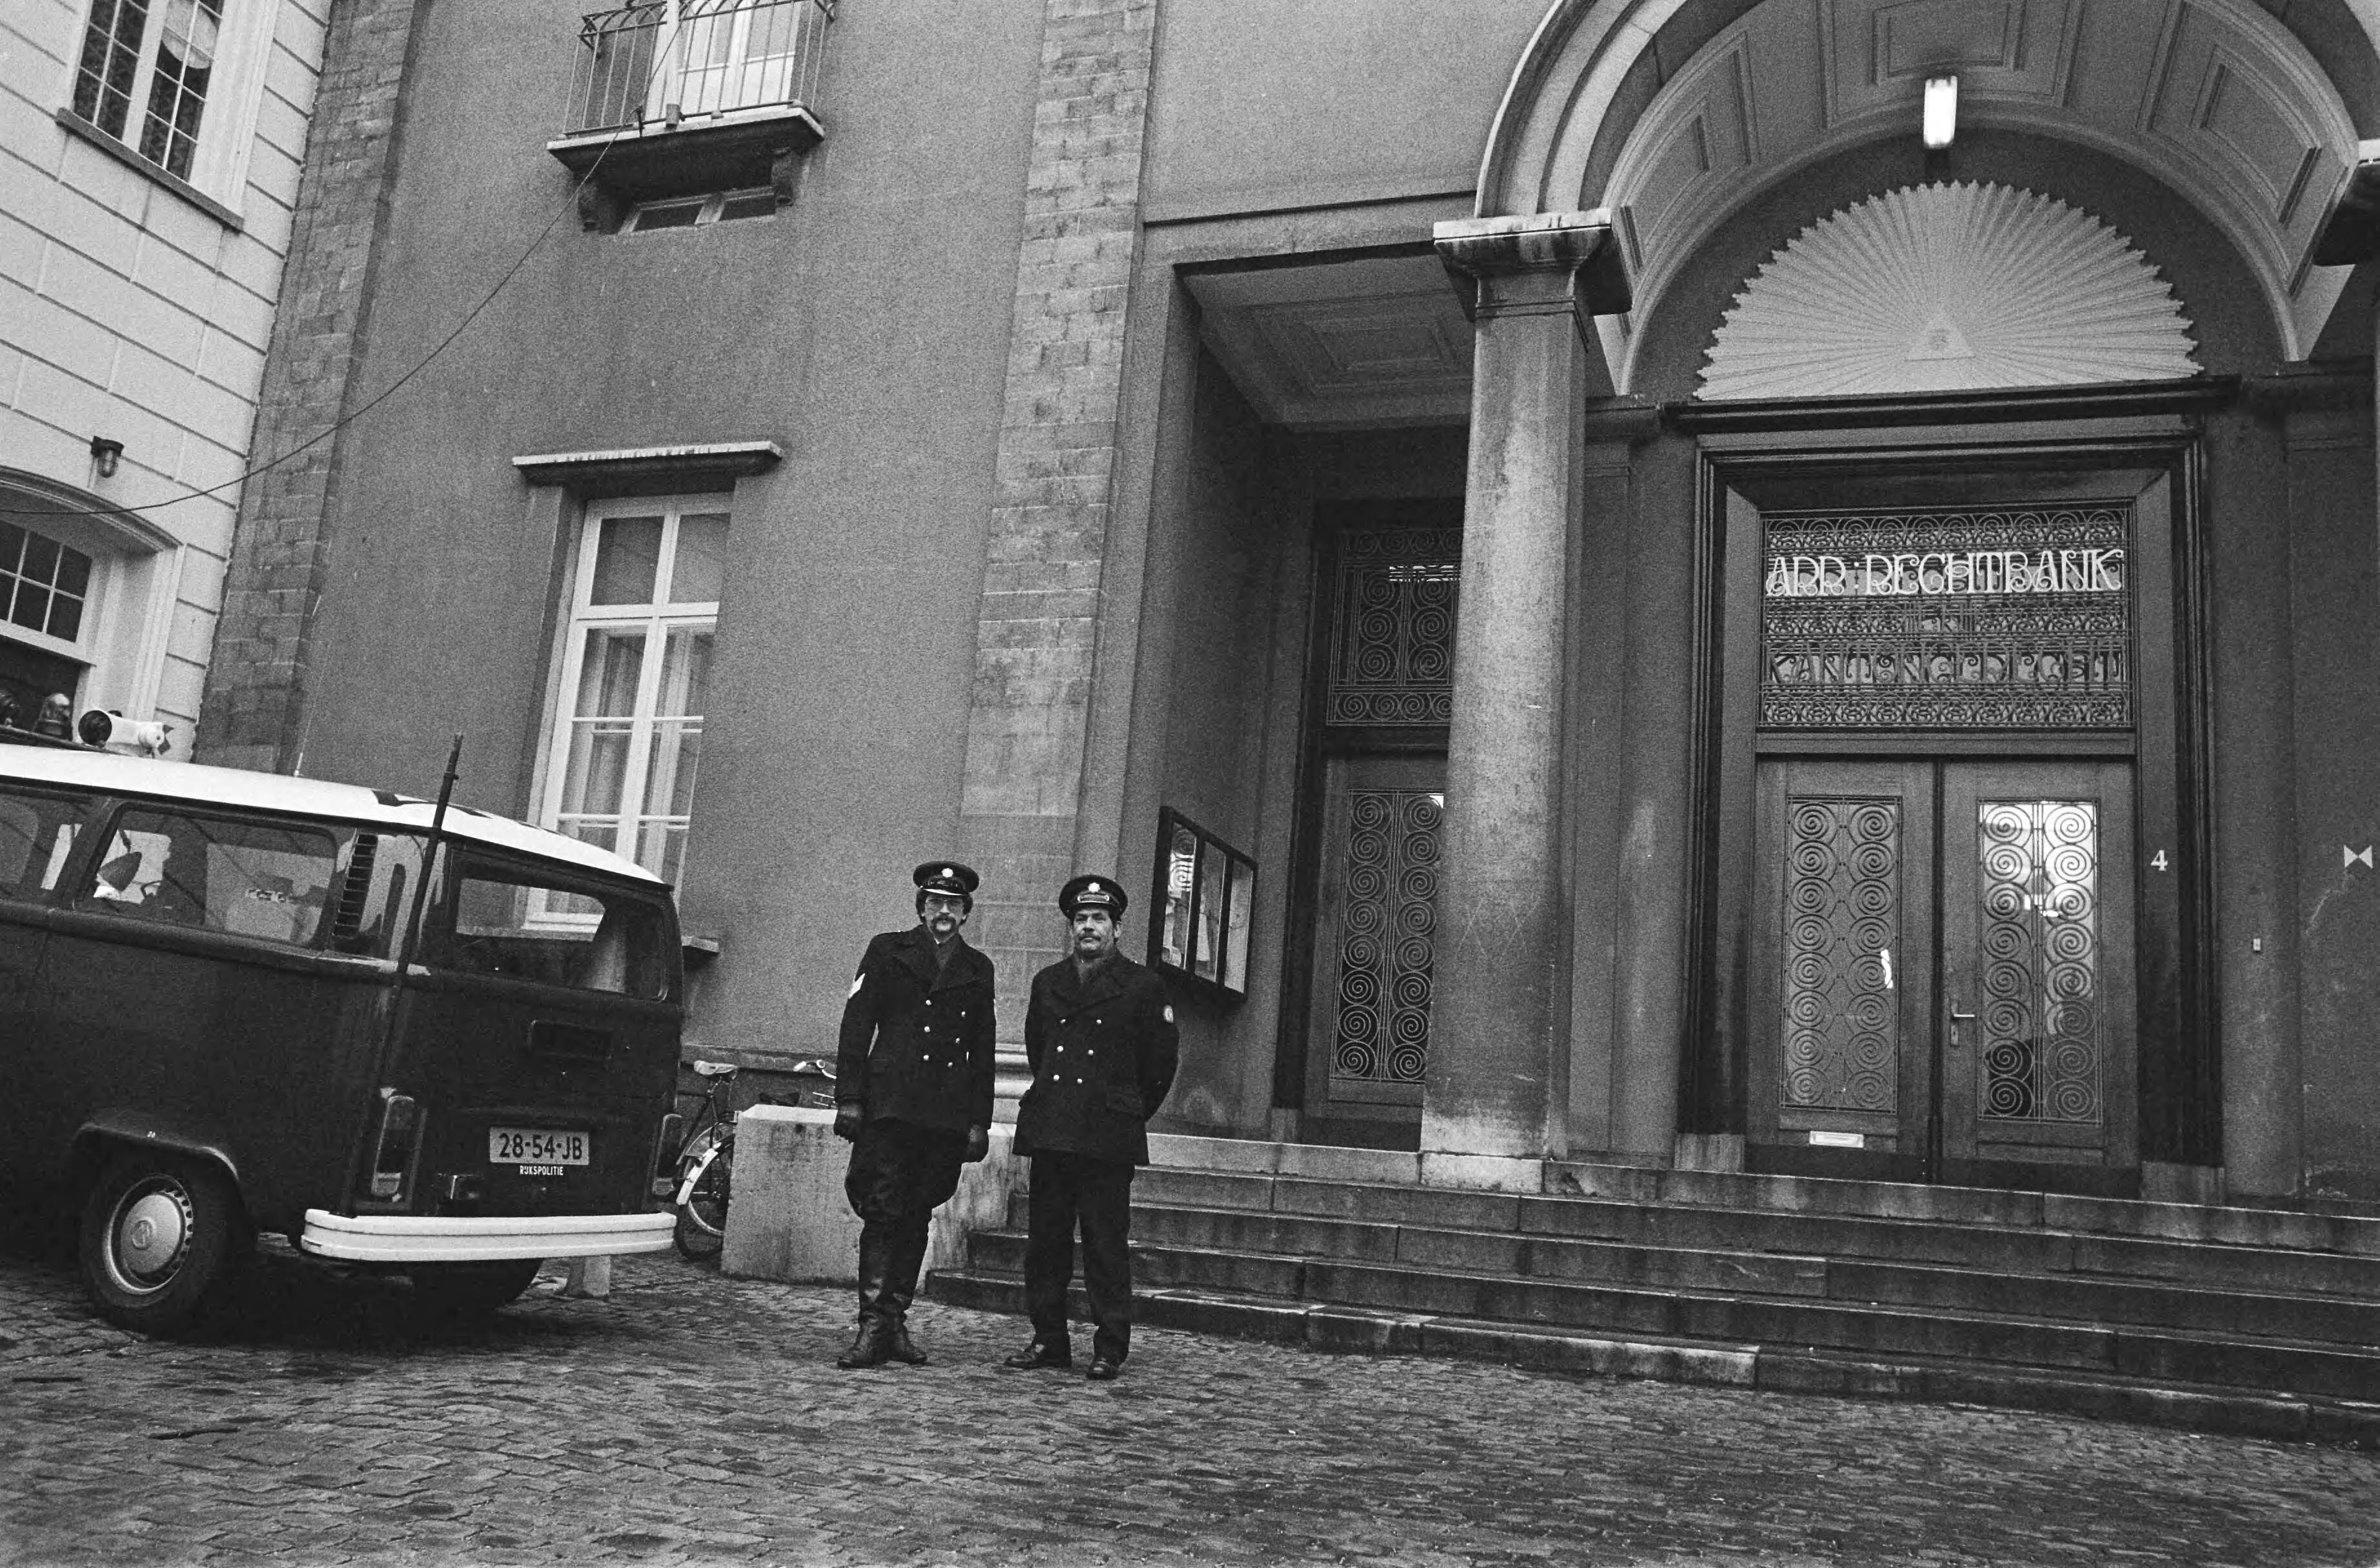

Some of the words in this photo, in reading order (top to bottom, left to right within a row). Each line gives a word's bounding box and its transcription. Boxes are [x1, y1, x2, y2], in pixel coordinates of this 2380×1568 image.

[1865, 548, 2124, 596] RECHTBANK
[1766, 639, 2124, 684] KANTONGERECHT
[2151, 849, 2168, 871] 4
[498, 1132, 583, 1160] 28-54-JB
[519, 1165, 564, 1176] RIJKSPOLITIE
